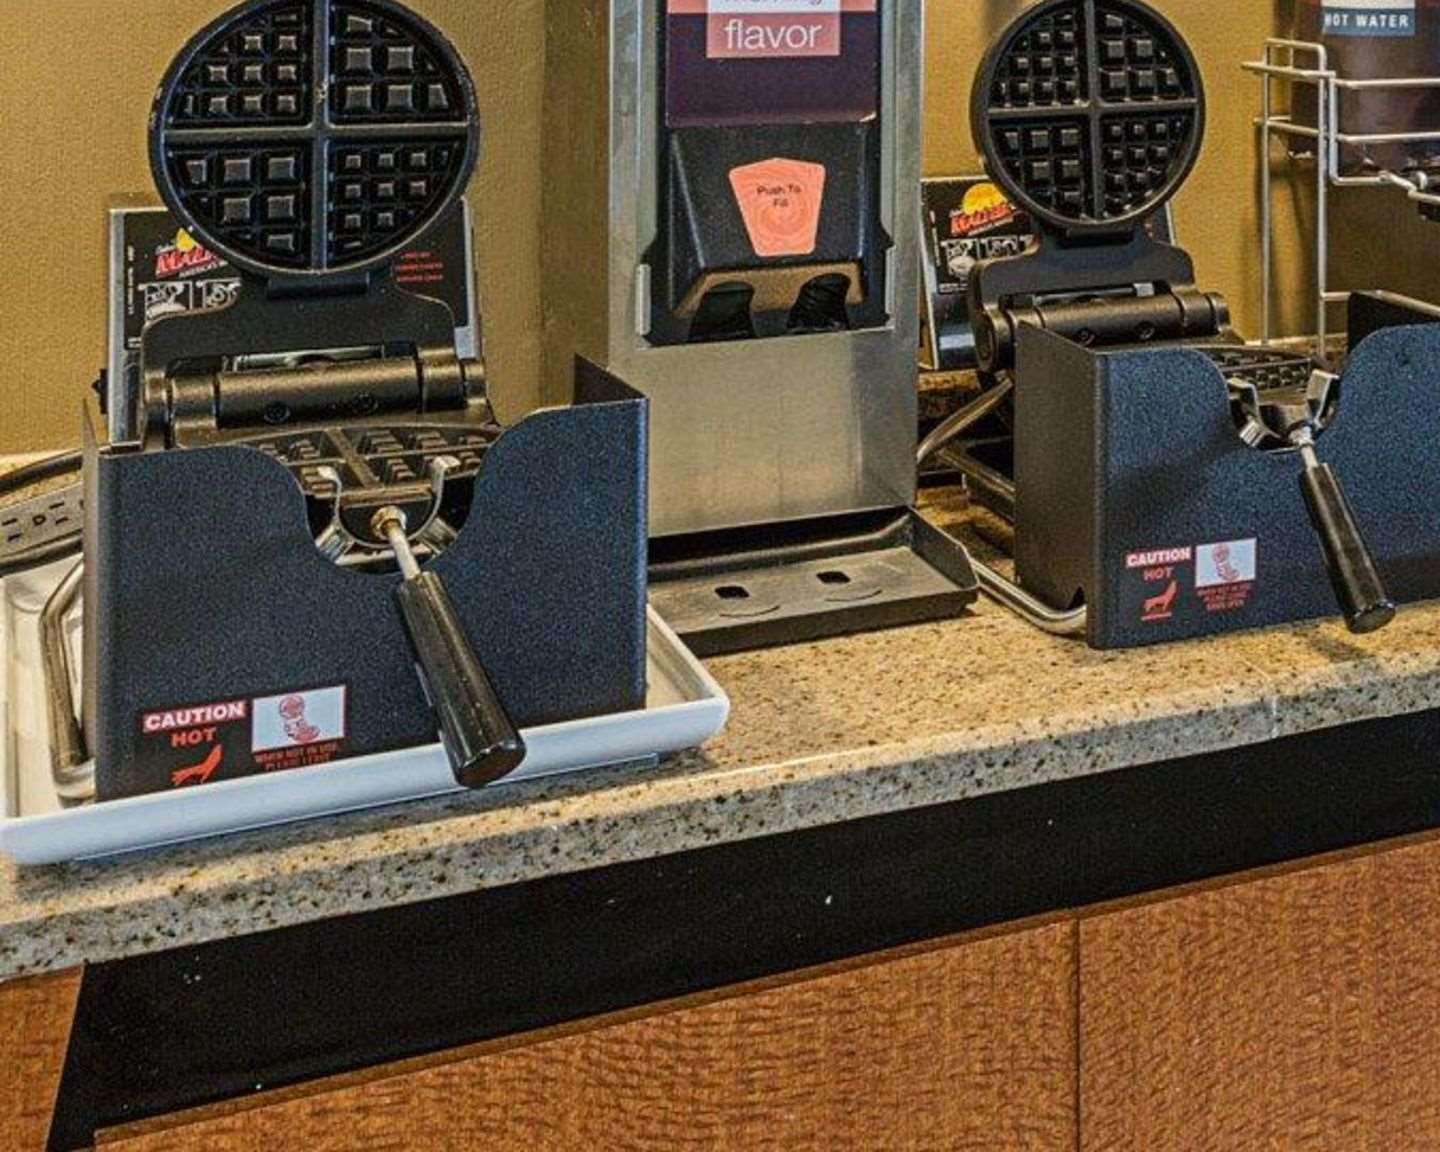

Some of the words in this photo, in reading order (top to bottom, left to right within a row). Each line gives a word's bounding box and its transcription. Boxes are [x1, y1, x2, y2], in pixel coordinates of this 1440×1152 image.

[1323, 12, 1349, 27] HOT
[1355, 13, 1409, 28] WATER
[723, 18, 823, 50] flavor
[1125, 546, 1192, 568] CAUTION
[1143, 566, 1174, 581] HOT
[143, 701, 247, 732] CAUTION
[170, 727, 217, 747] HOT
